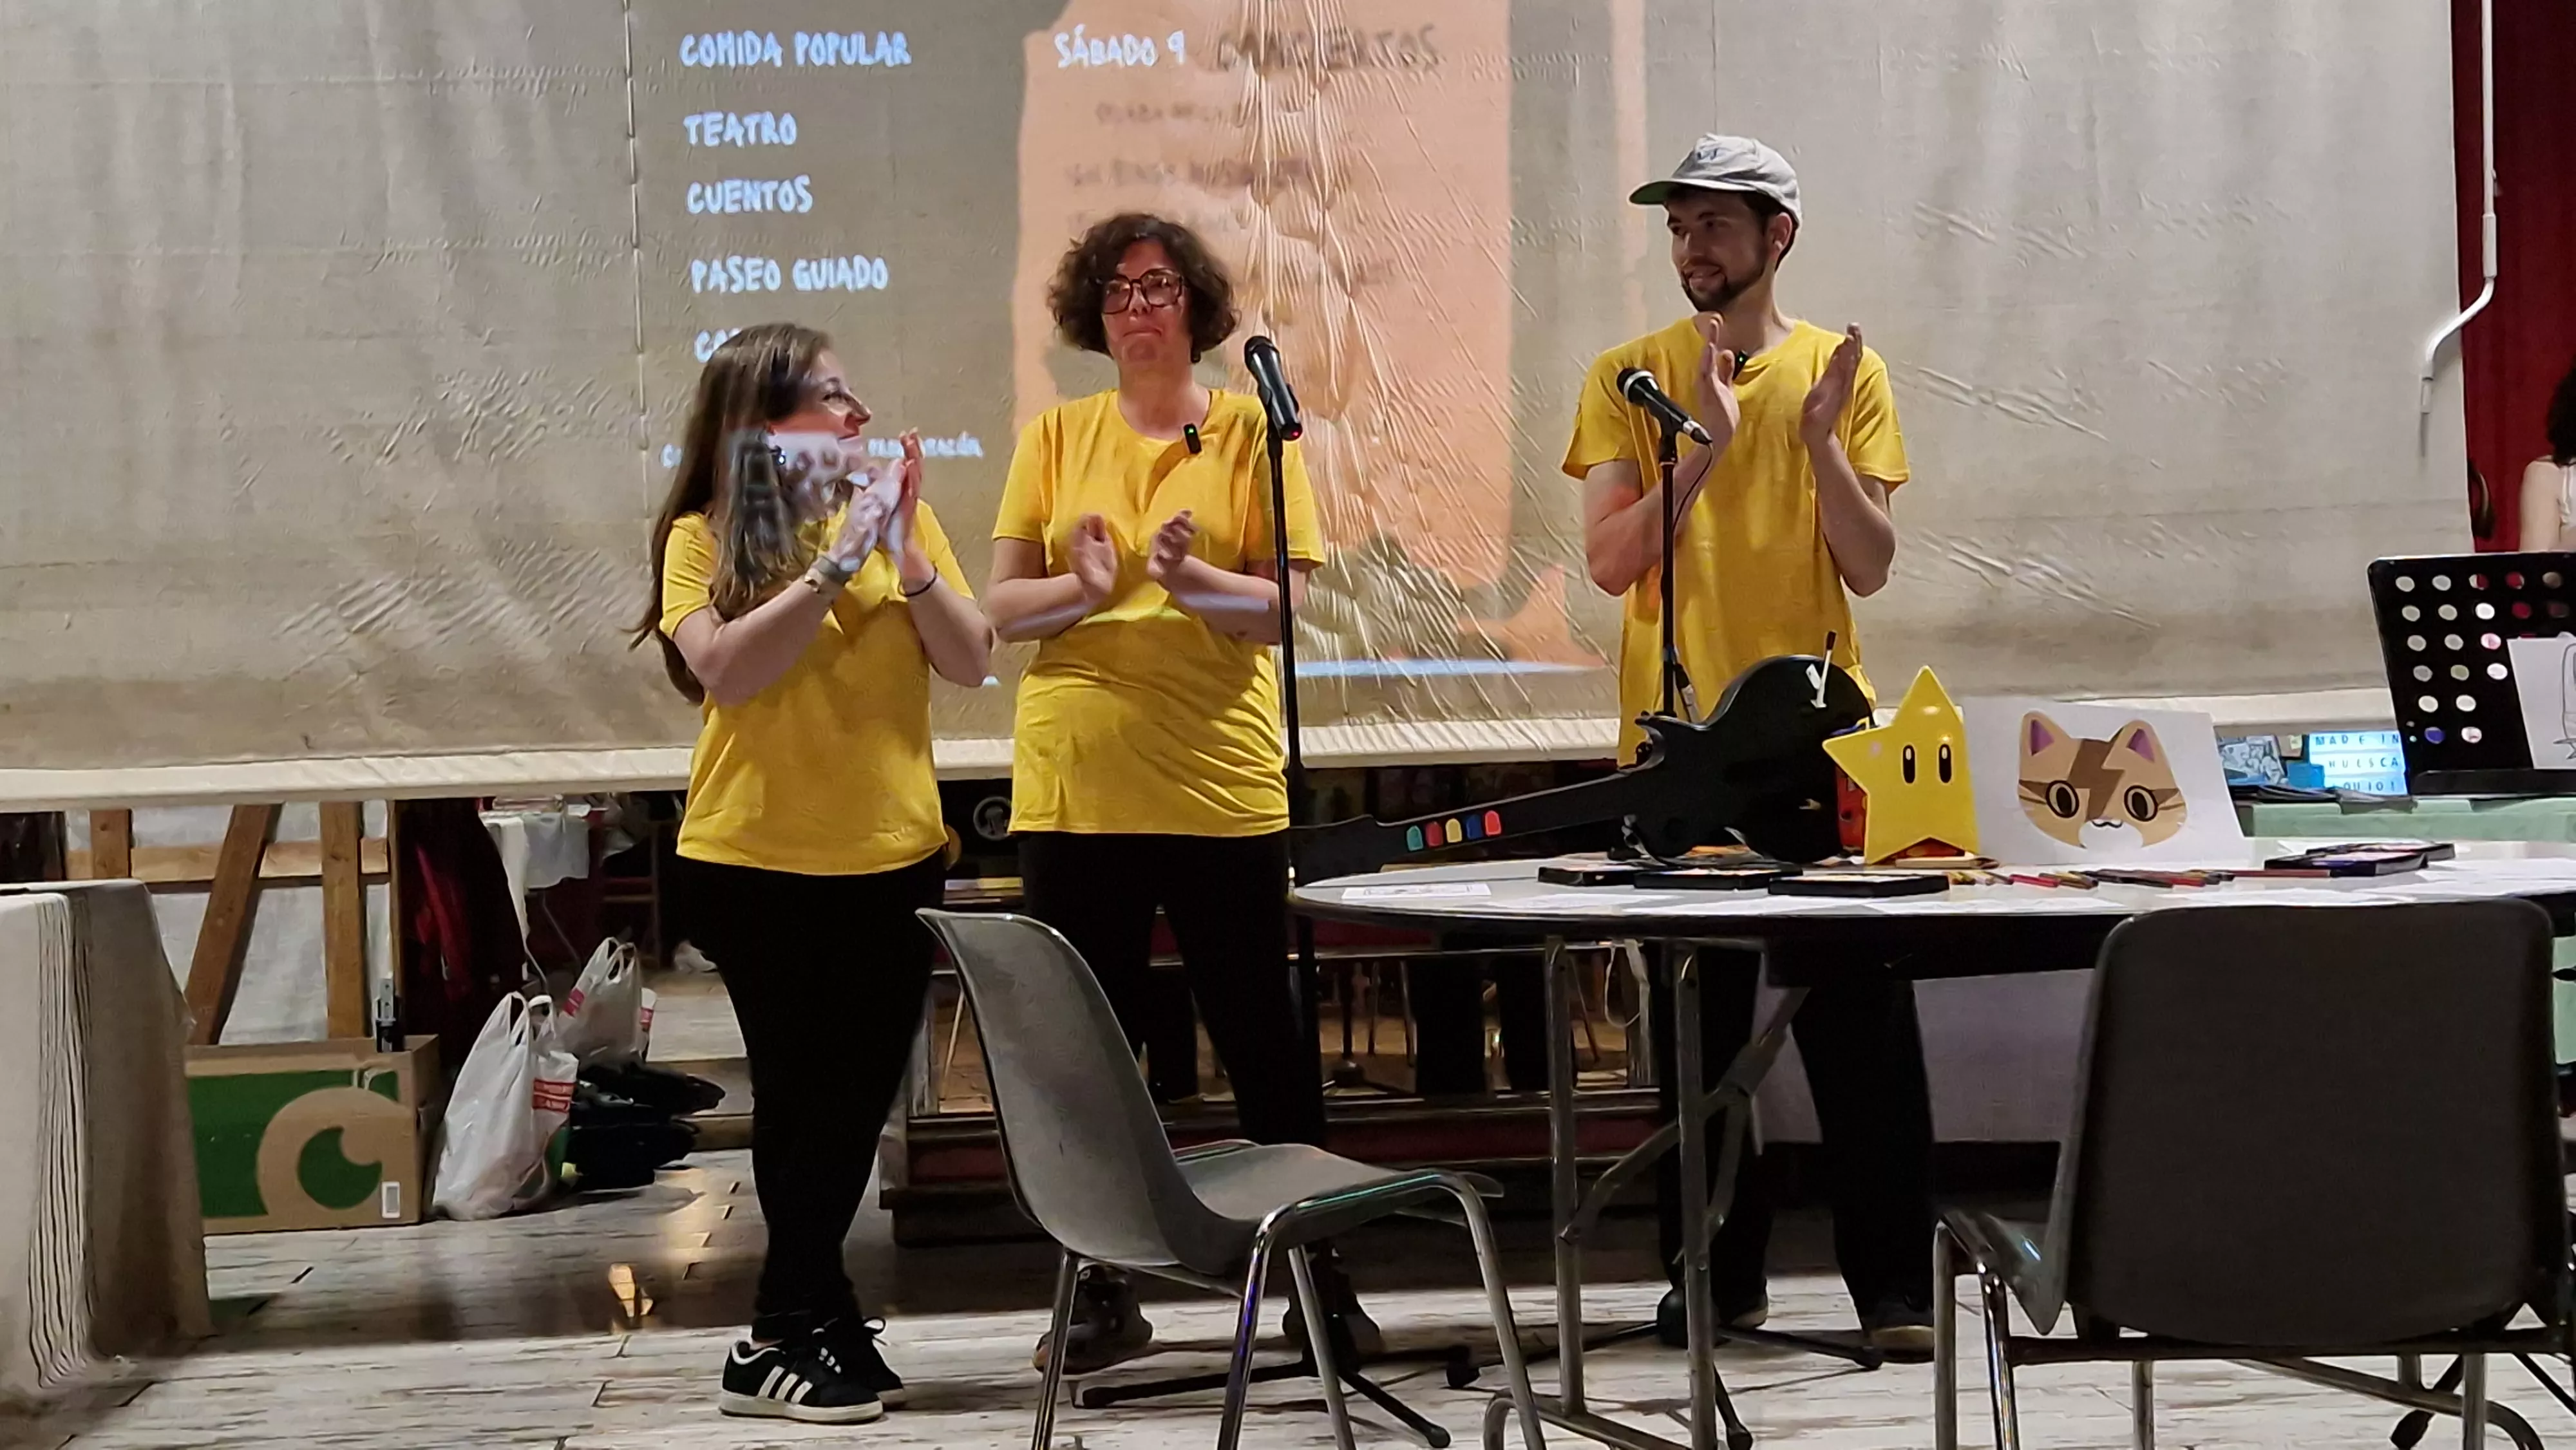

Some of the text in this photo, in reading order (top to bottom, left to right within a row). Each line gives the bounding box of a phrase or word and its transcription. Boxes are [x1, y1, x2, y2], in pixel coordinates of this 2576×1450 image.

[680, 30, 911, 66] COMIDA POPULAR
[1054, 24, 1186, 67] SÁBADO 9
[684, 111, 797, 146] TEATRO
[688, 175, 813, 213] CUENTOS
[692, 256, 888, 292] PASEO GUIADO
[2316, 733, 2399, 746] MADE IN
